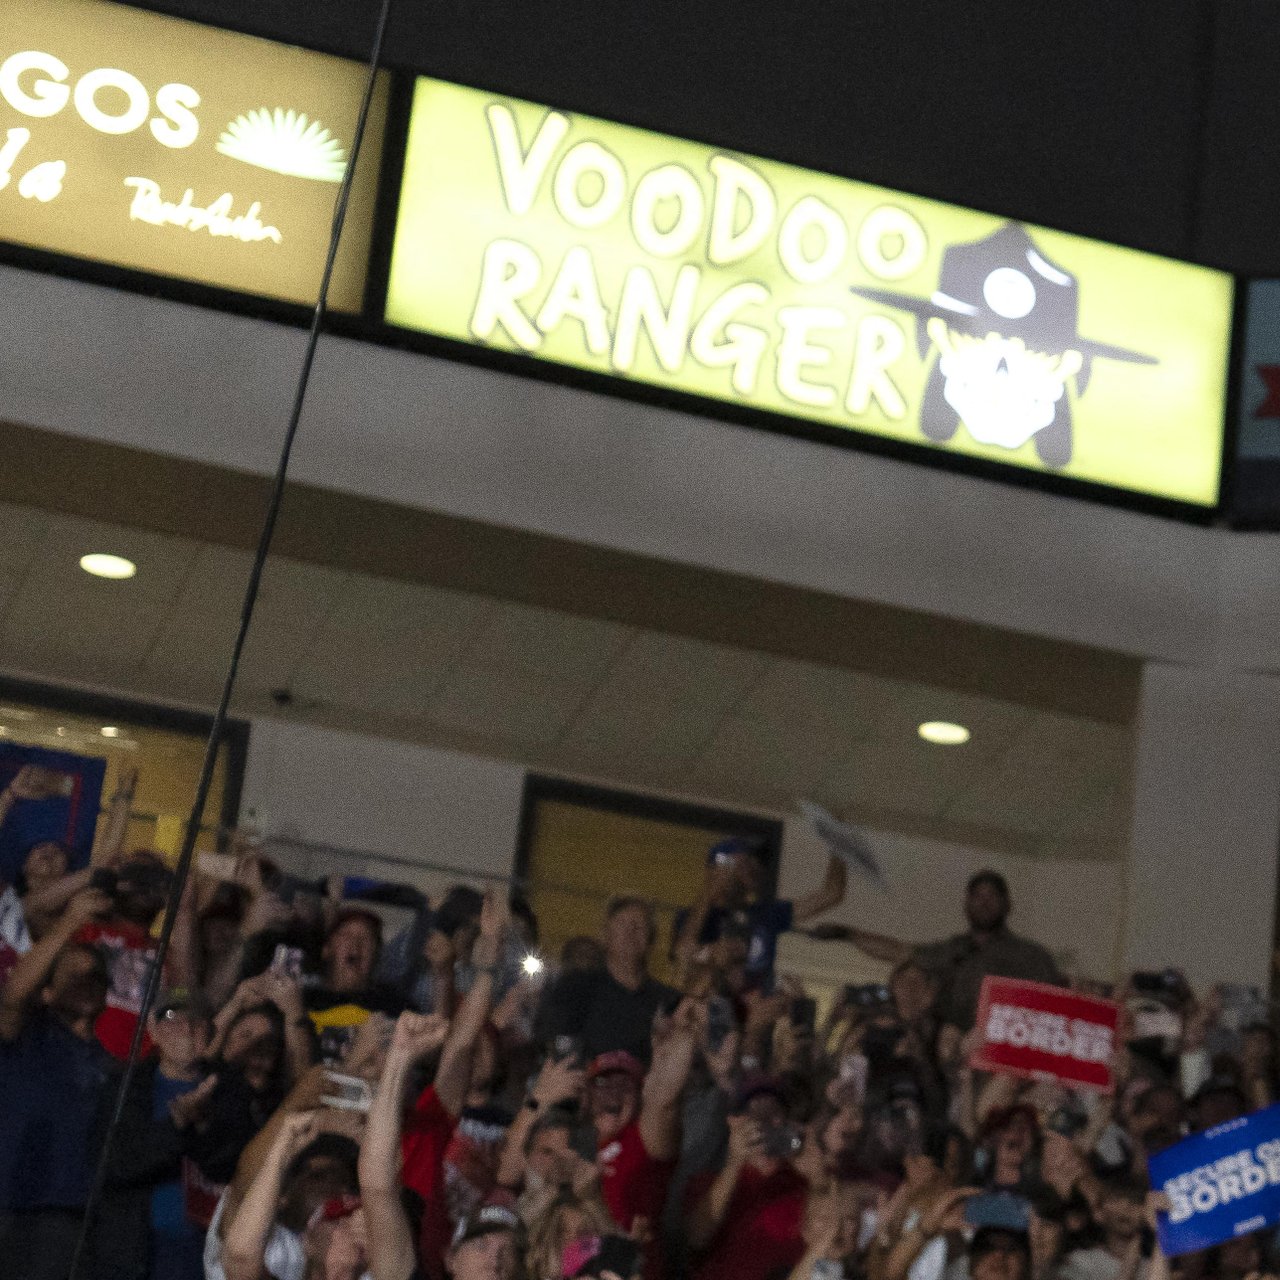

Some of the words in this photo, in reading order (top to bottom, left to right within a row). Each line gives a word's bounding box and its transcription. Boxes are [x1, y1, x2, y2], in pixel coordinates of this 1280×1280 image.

[0, 50, 201, 149] GOS
[485, 102, 929, 285] VOODOO
[469, 238, 908, 420] RANGER
[985, 1021, 1114, 1064] BORDER
